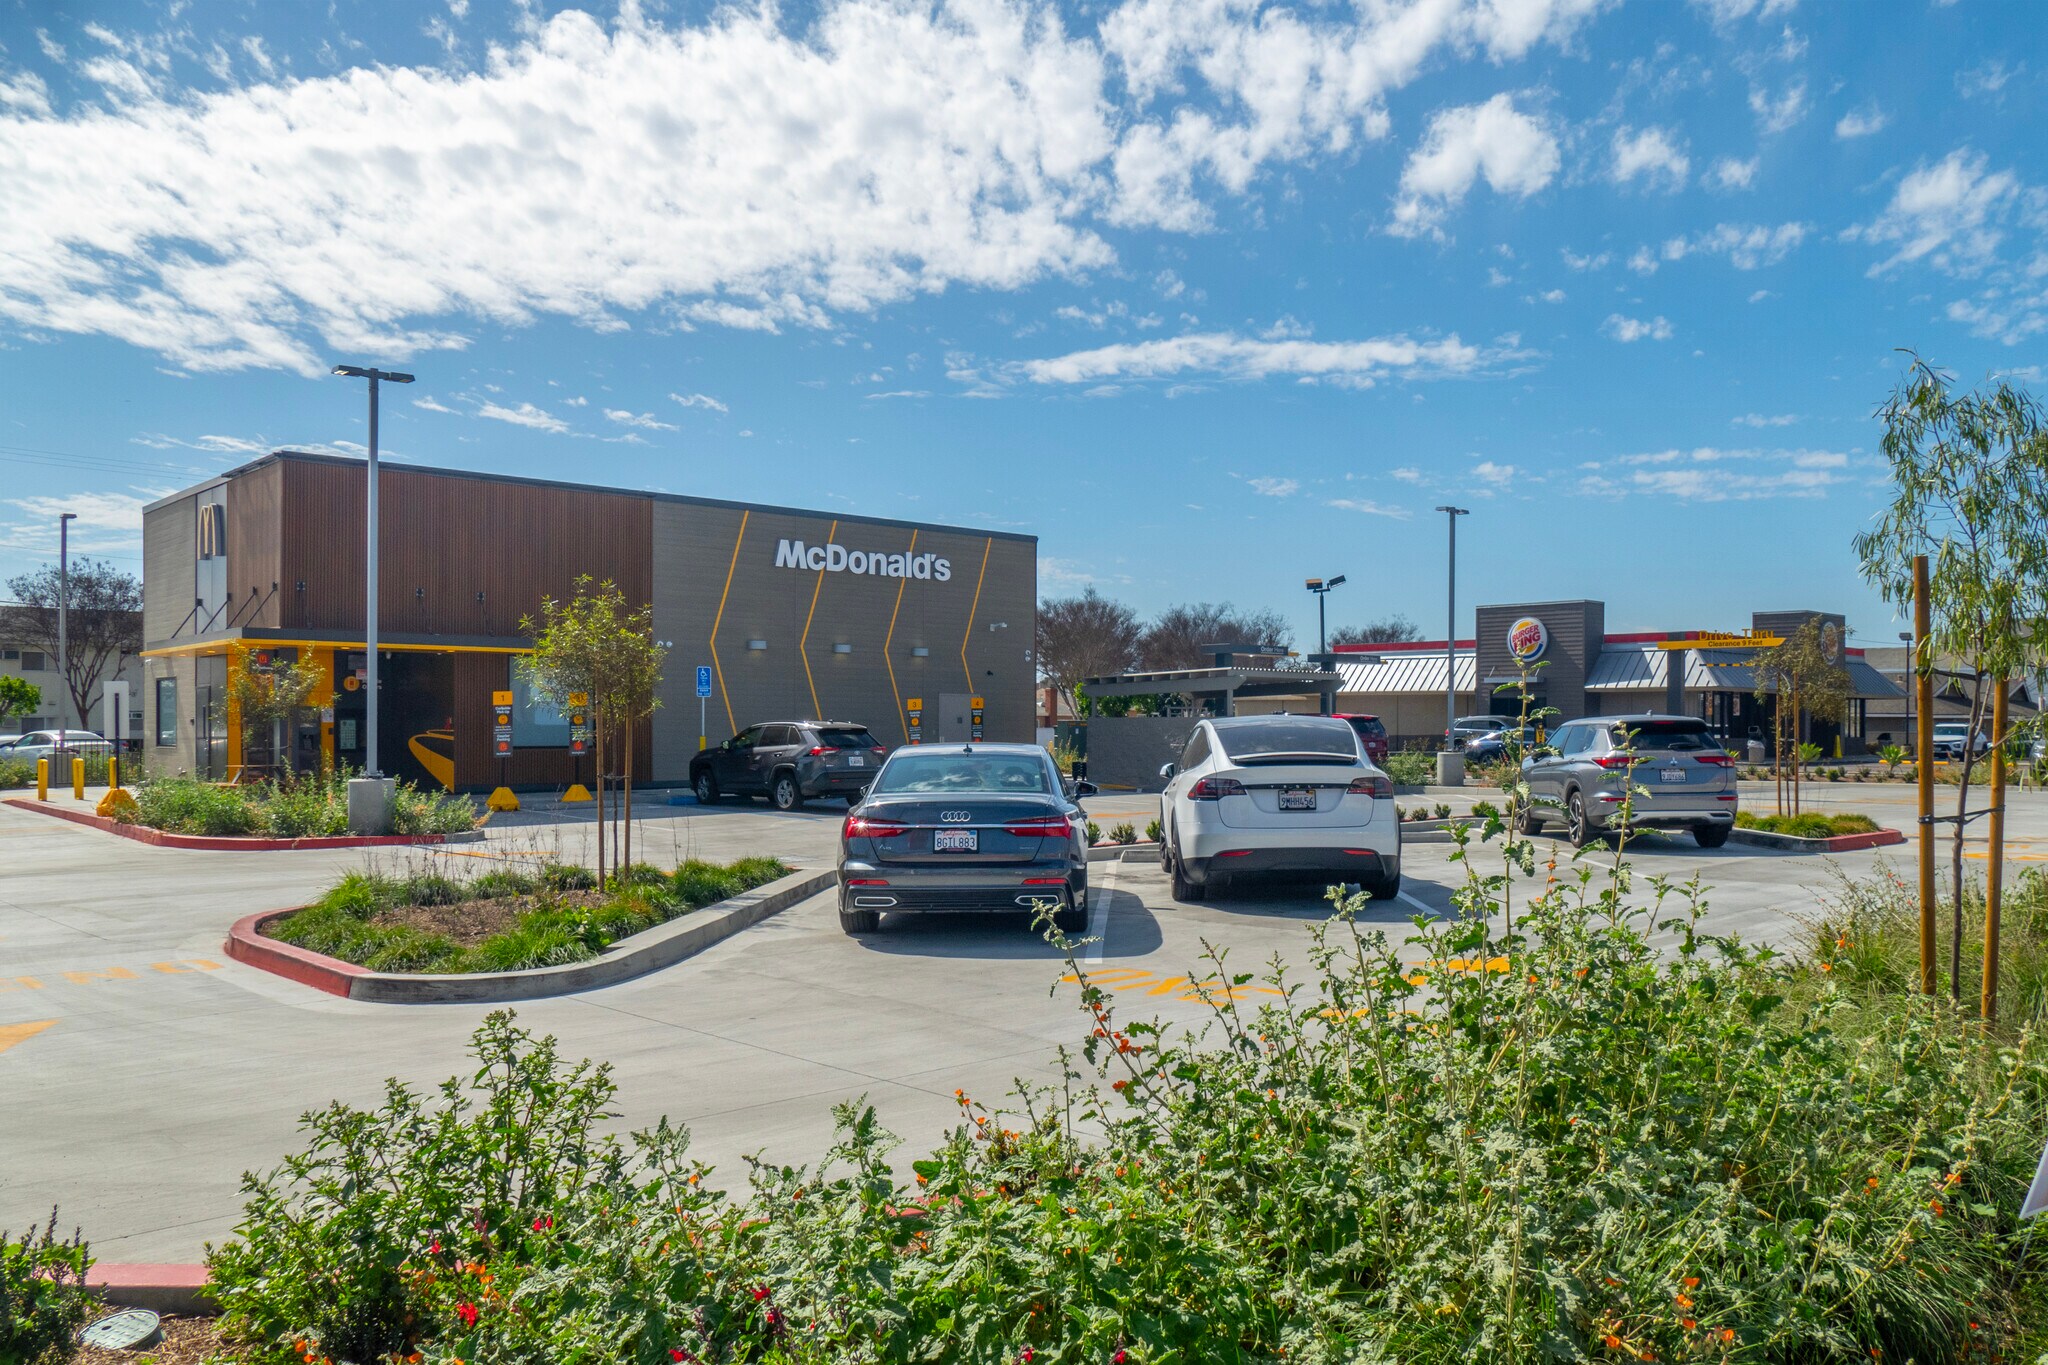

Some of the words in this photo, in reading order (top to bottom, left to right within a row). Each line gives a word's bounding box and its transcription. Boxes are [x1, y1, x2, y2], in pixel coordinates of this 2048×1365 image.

[775, 539, 951, 581] McDonald's
[1512, 624, 1539, 642] BURGER
[1281, 797, 1314, 806] 9MHH456
[936, 837, 975, 848] 8GIL883
